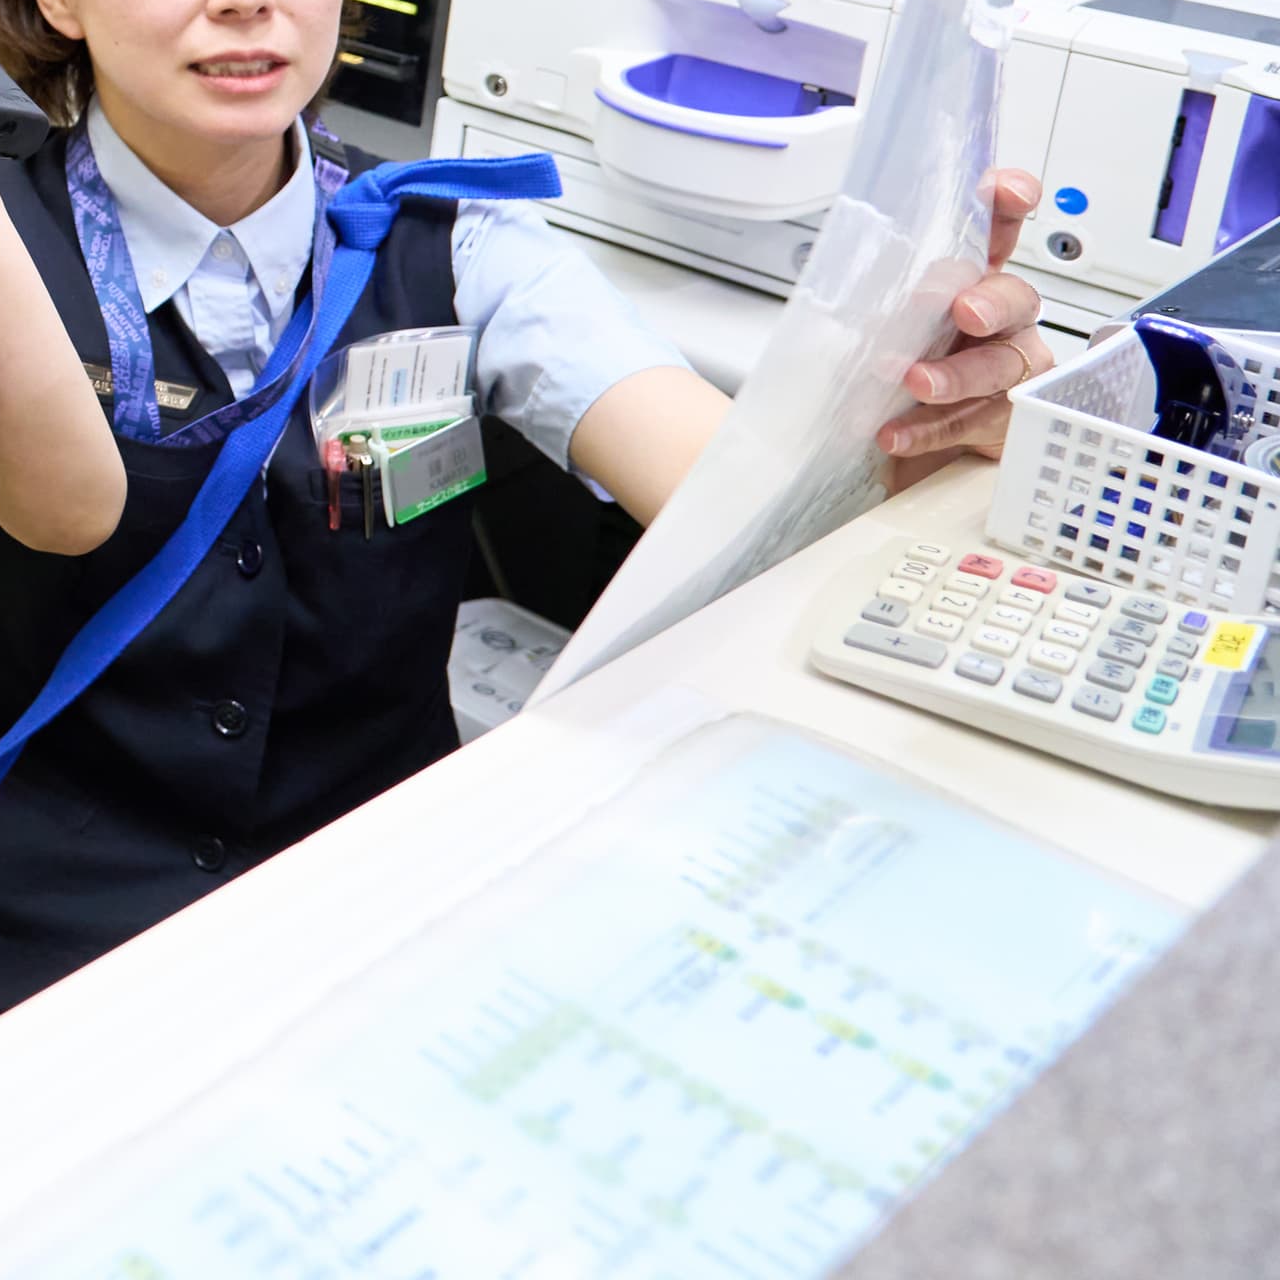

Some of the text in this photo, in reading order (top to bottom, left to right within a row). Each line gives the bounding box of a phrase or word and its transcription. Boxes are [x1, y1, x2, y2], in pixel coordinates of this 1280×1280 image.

[100, 281, 145, 324] JUJUTSU
[104, 302, 142, 342] JUJUTSU
[941, 595, 968, 607] 2
[927, 617, 954, 629] 3
[1052, 626, 1080, 638] 8
